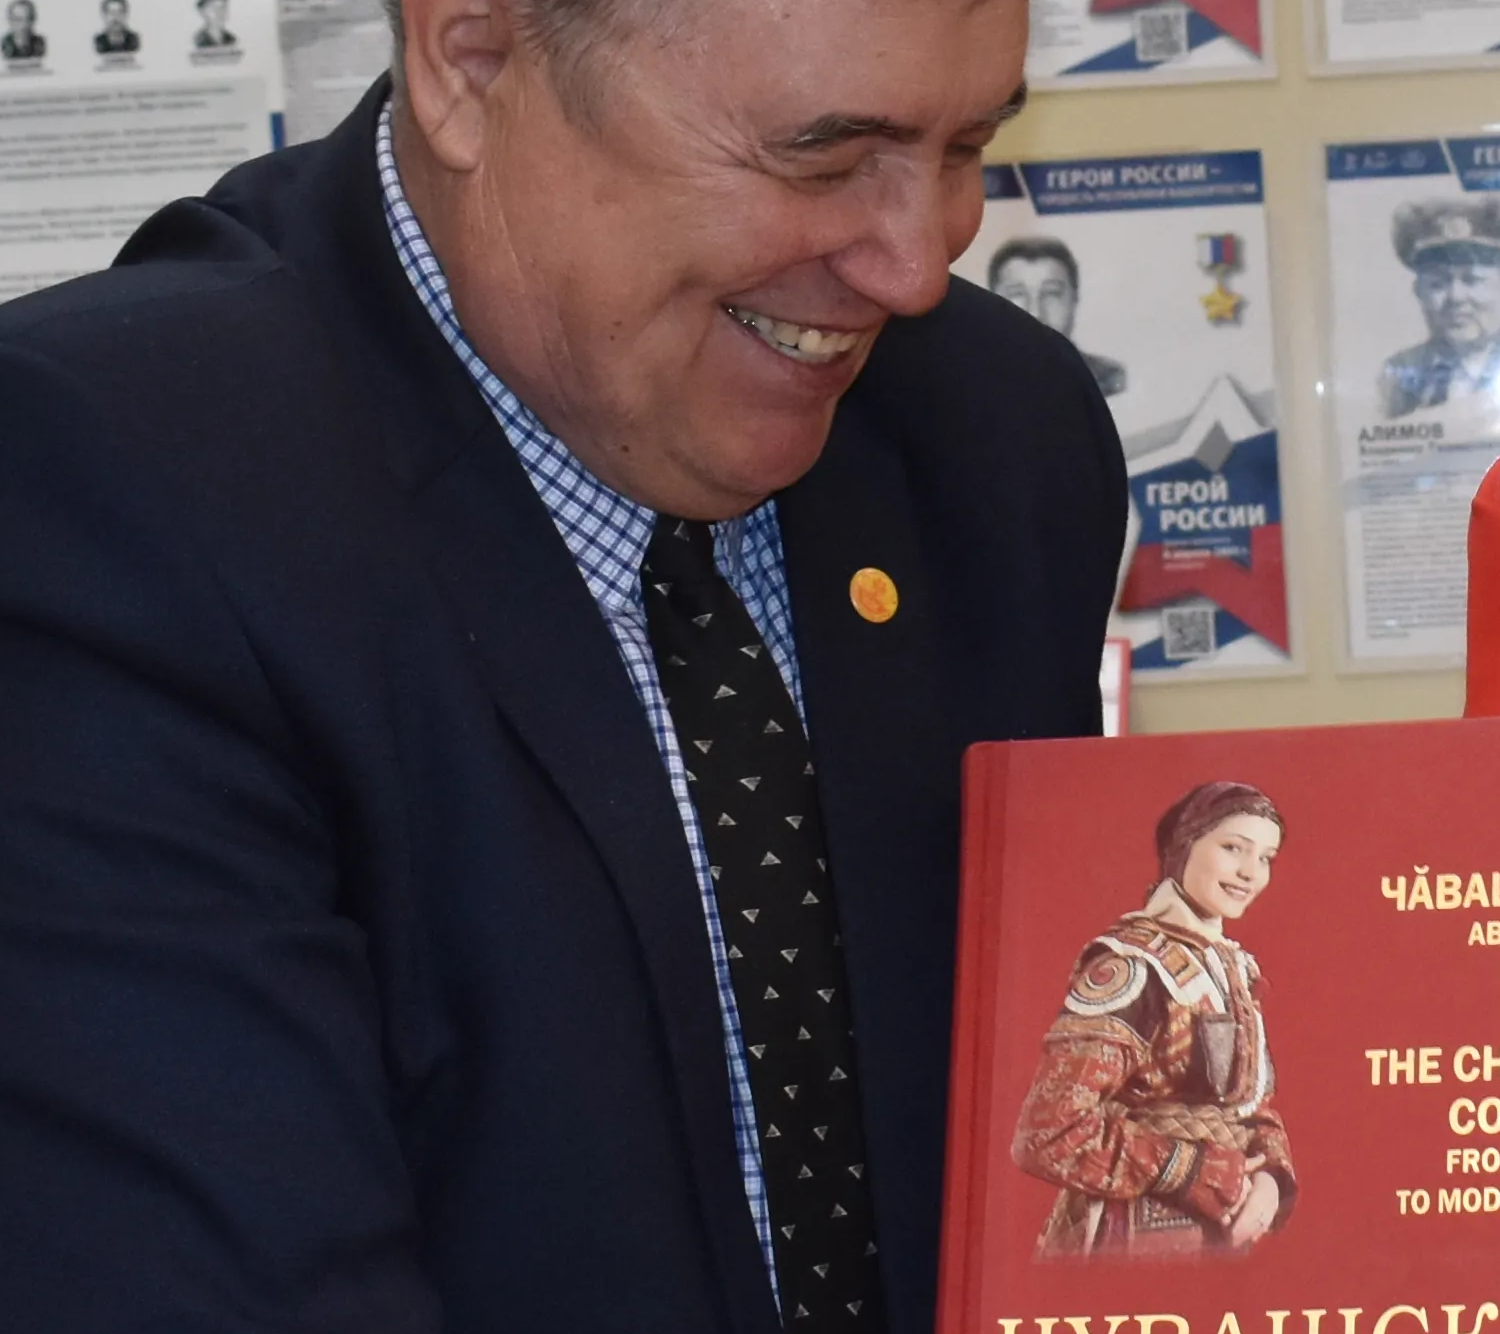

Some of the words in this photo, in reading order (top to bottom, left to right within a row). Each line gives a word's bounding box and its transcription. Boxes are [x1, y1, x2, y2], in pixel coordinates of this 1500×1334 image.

[1047, 167, 1114, 188] ГЕРОИ
[1120, 162, 1207, 185] РОССИИ
[1358, 422, 1444, 443] АЛИМОВ
[1146, 474, 1229, 506] ГЕРОЙ
[1160, 504, 1266, 532] РОССИИ
[1365, 1047, 1442, 1086] THE
[1396, 1187, 1432, 1214] TO
